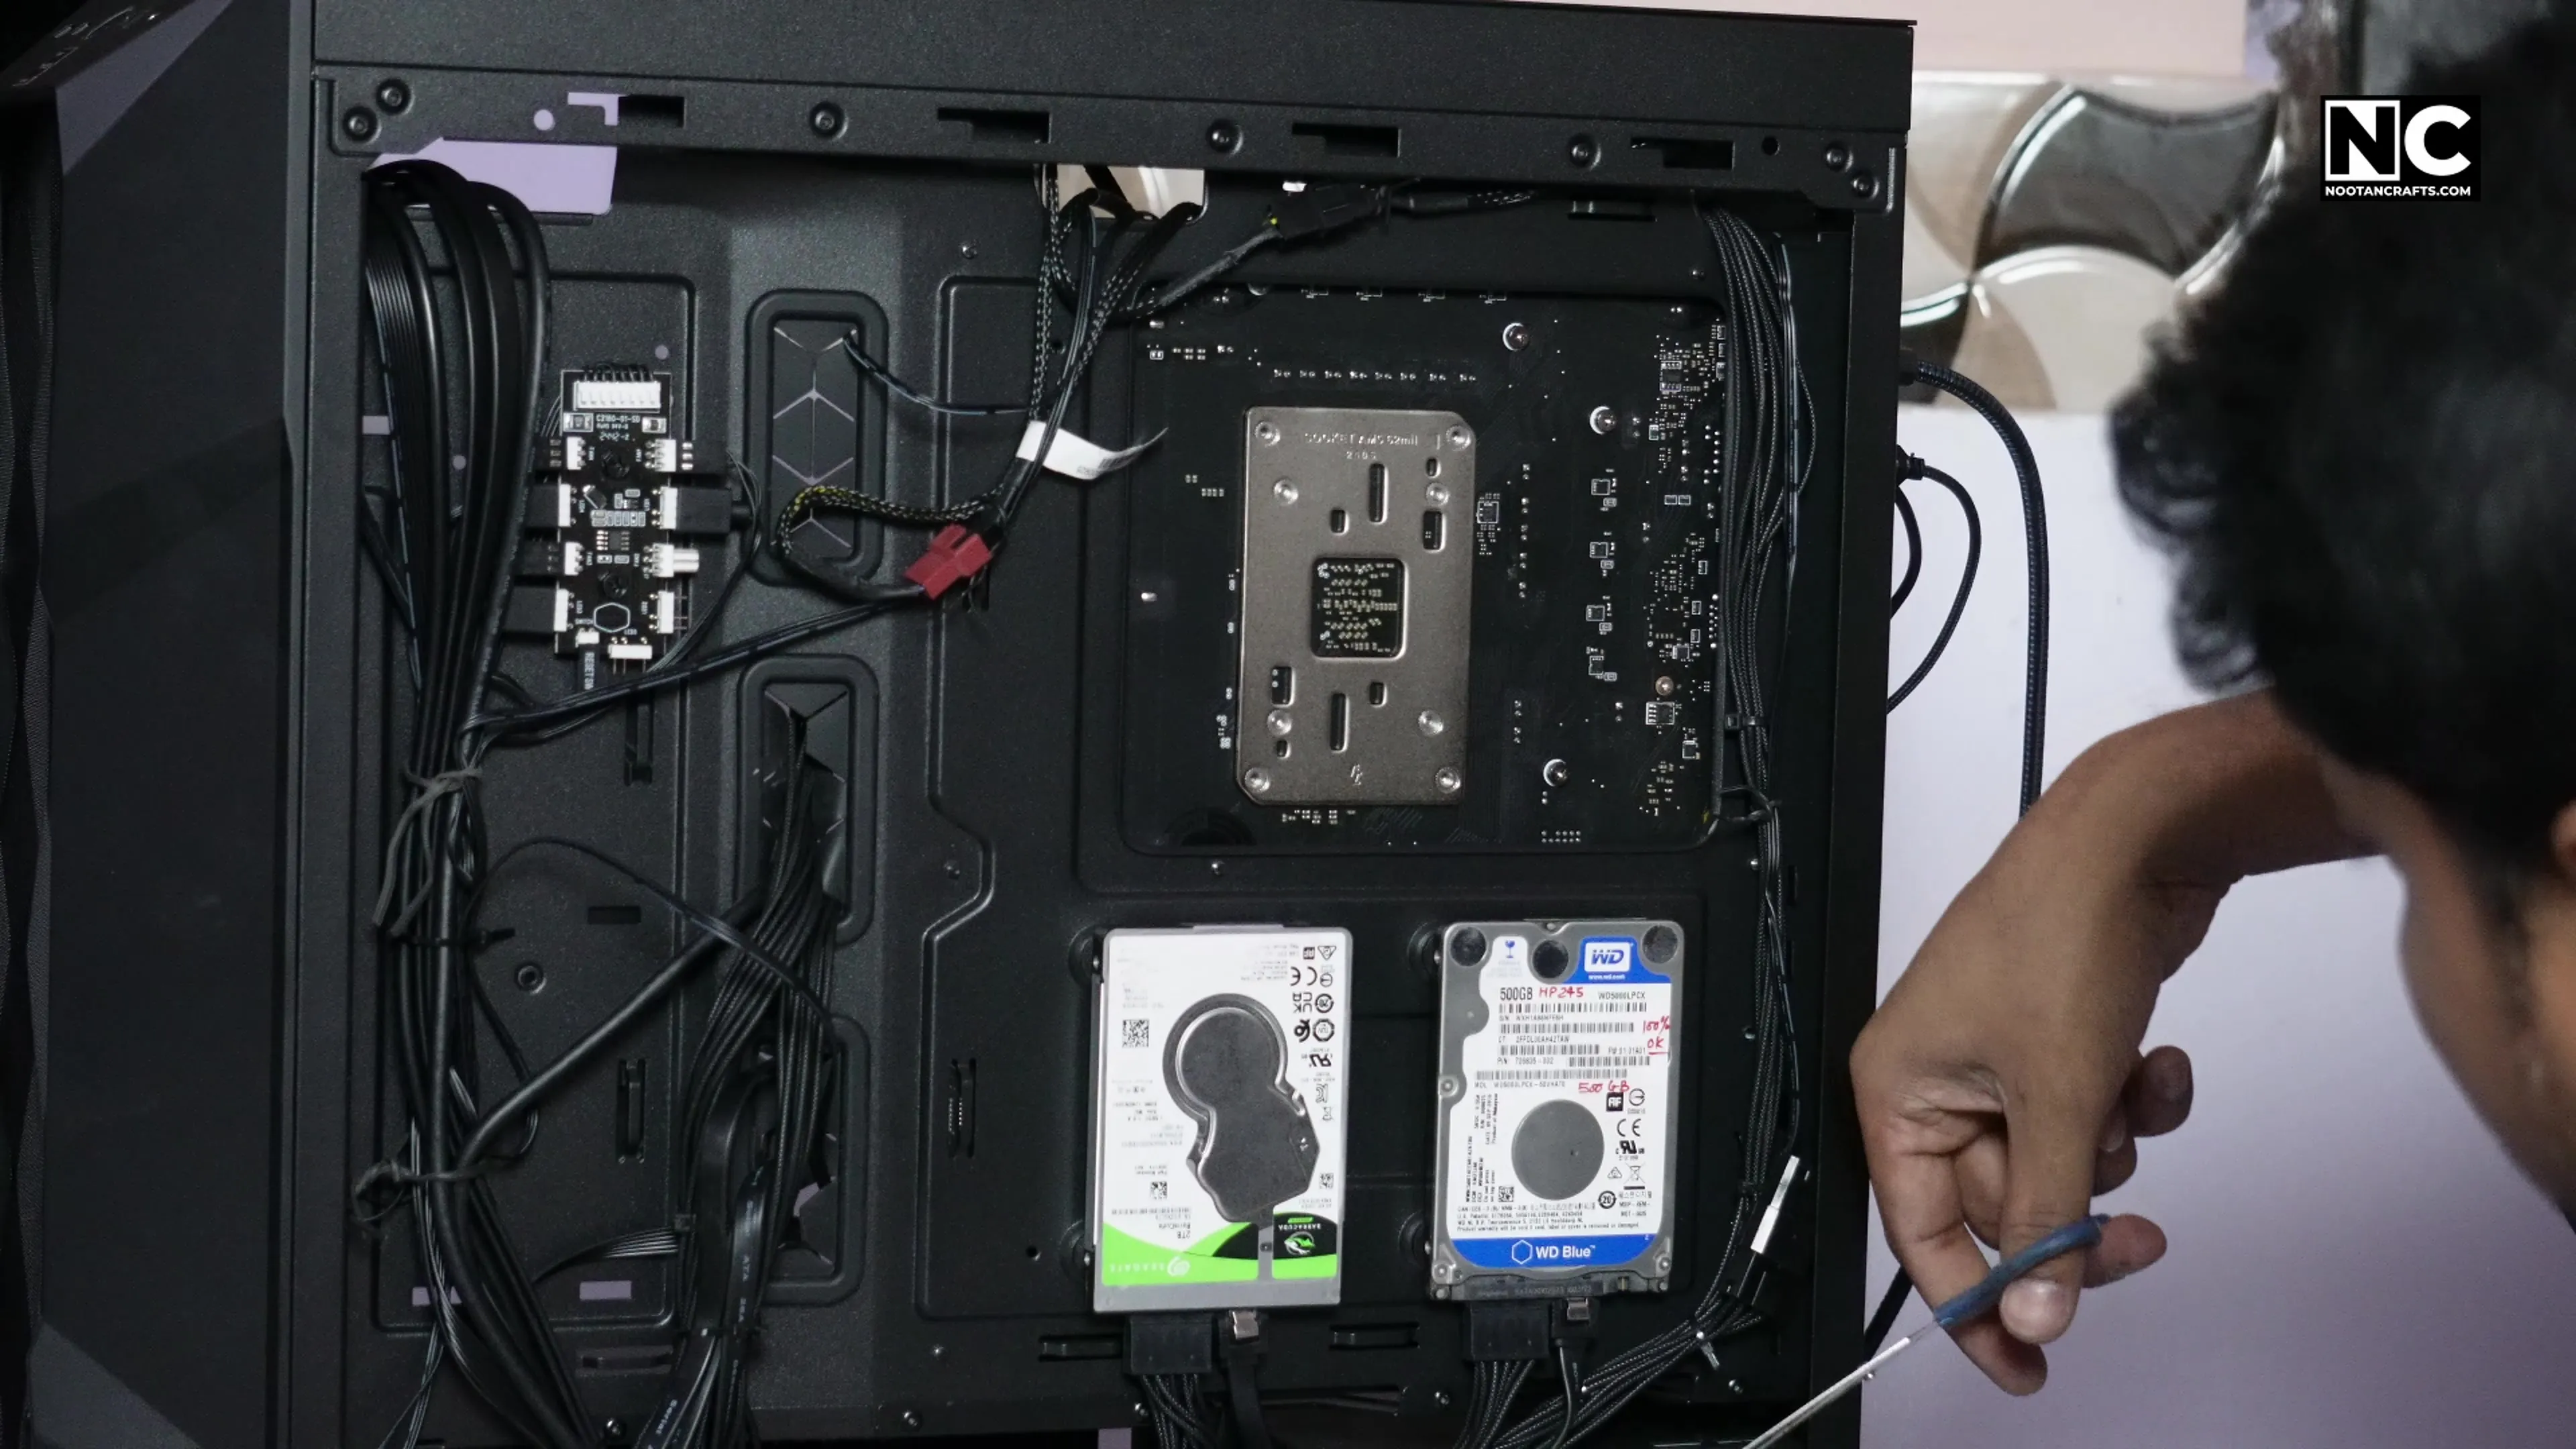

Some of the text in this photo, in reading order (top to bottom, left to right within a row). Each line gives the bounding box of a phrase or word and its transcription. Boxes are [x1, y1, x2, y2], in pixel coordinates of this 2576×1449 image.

[1305, 433, 1356, 444] SOCKET
[584, 652, 595, 676] RESET
[1591, 949, 1624, 965] WD
[1499, 987, 1533, 1000] 500GB
[1177, 1230, 1191, 1239] 2TB
[1536, 1246, 1558, 1258] WD
[741, 1255, 751, 1283] ATA
[1109, 1263, 1165, 1272] SEAGATE
